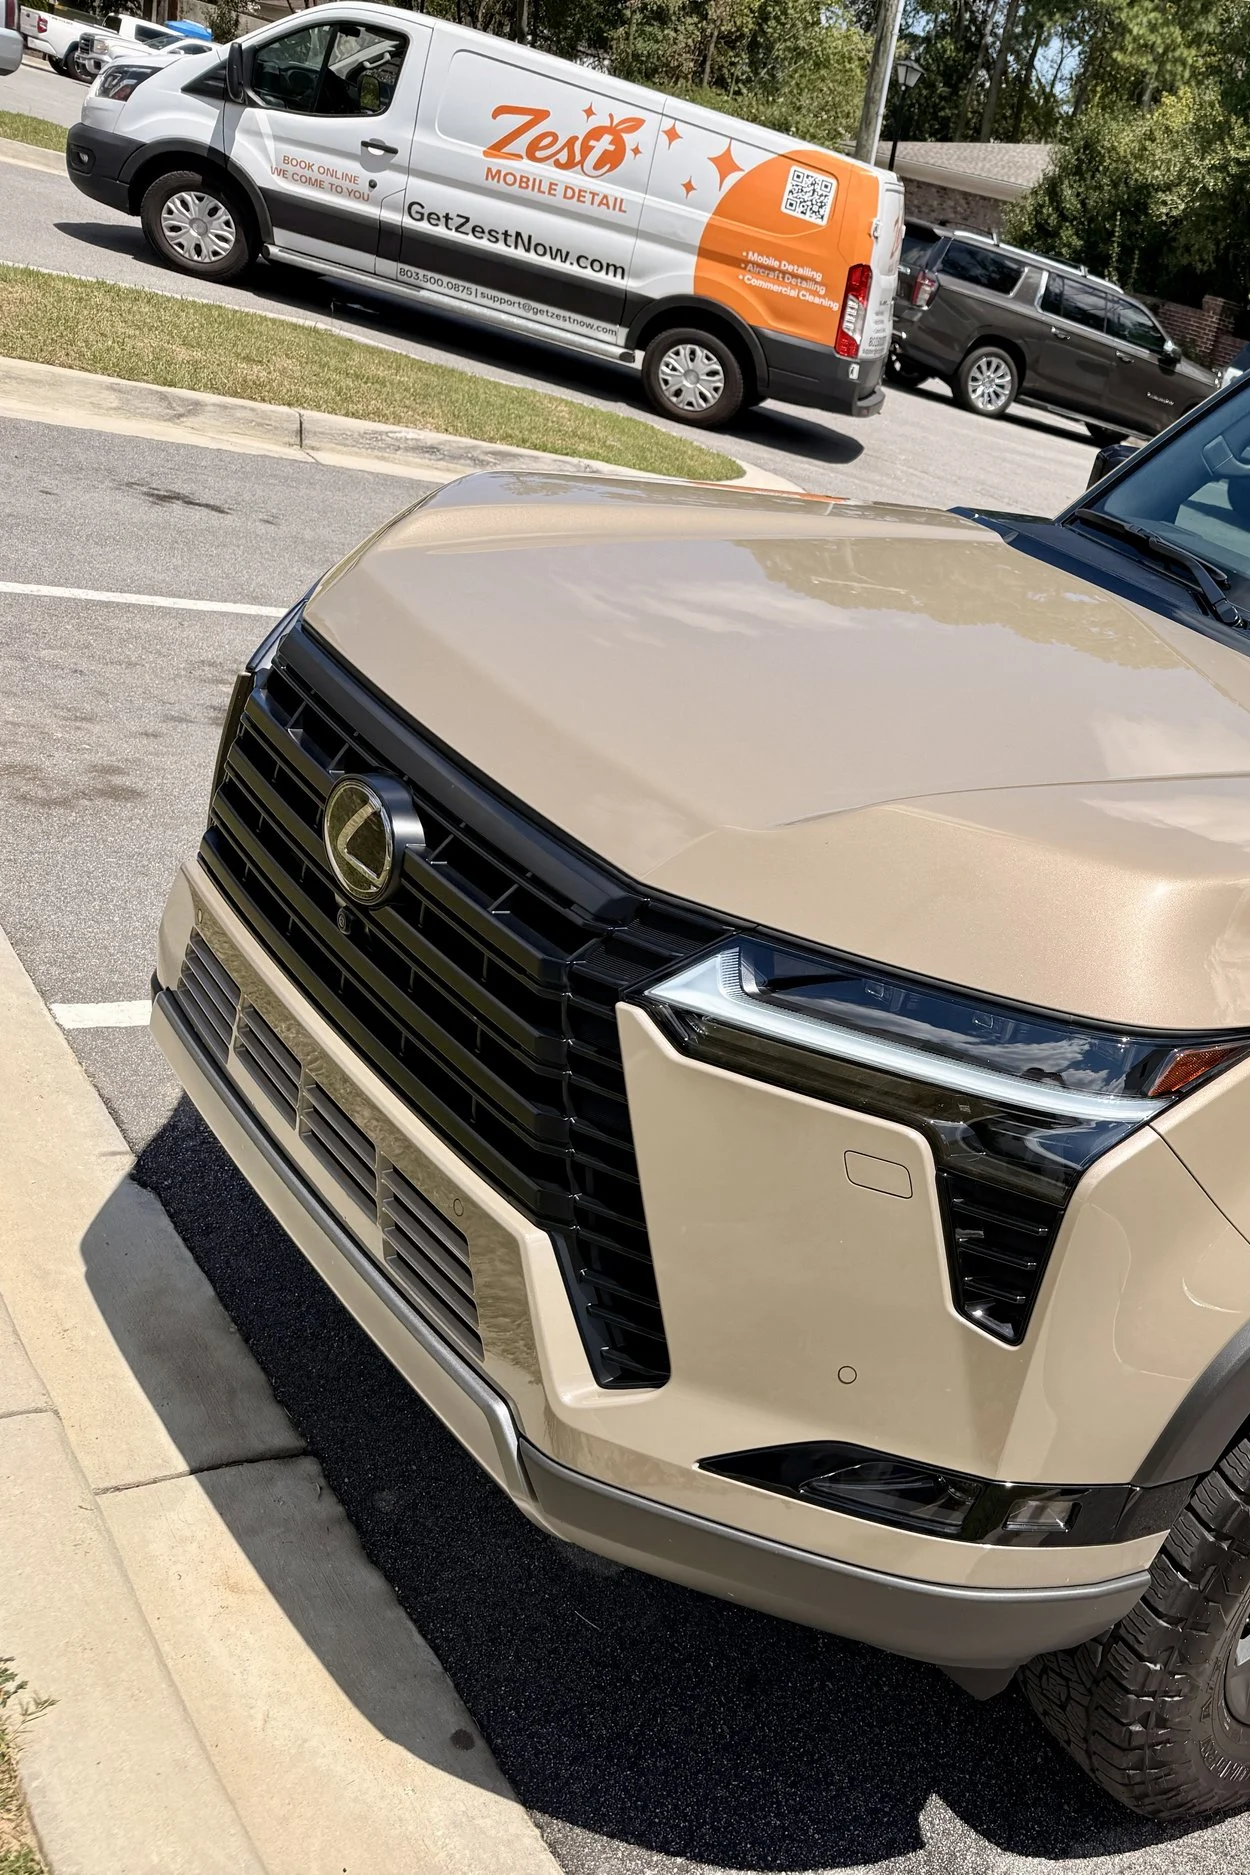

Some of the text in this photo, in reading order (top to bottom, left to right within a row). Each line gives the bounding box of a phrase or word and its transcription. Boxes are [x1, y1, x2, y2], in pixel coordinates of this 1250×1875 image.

[482, 104, 626, 178] Zest
[270, 165, 370, 202] WE COME TO YOU
[282, 154, 360, 185] BOOK ONLINE
[485, 167, 627, 213] MOBILE DETAIL
[407, 201, 626, 280] GetZestNow.com
[746, 263, 826, 295] Aircraft Detailing
[747, 251, 823, 282] Mobile Detailing
[399, 267, 473, 296] 803.500.0875
[480, 290, 618, 337] support@getzestnow.com
[744, 274, 840, 311] Commercial Cleaning
